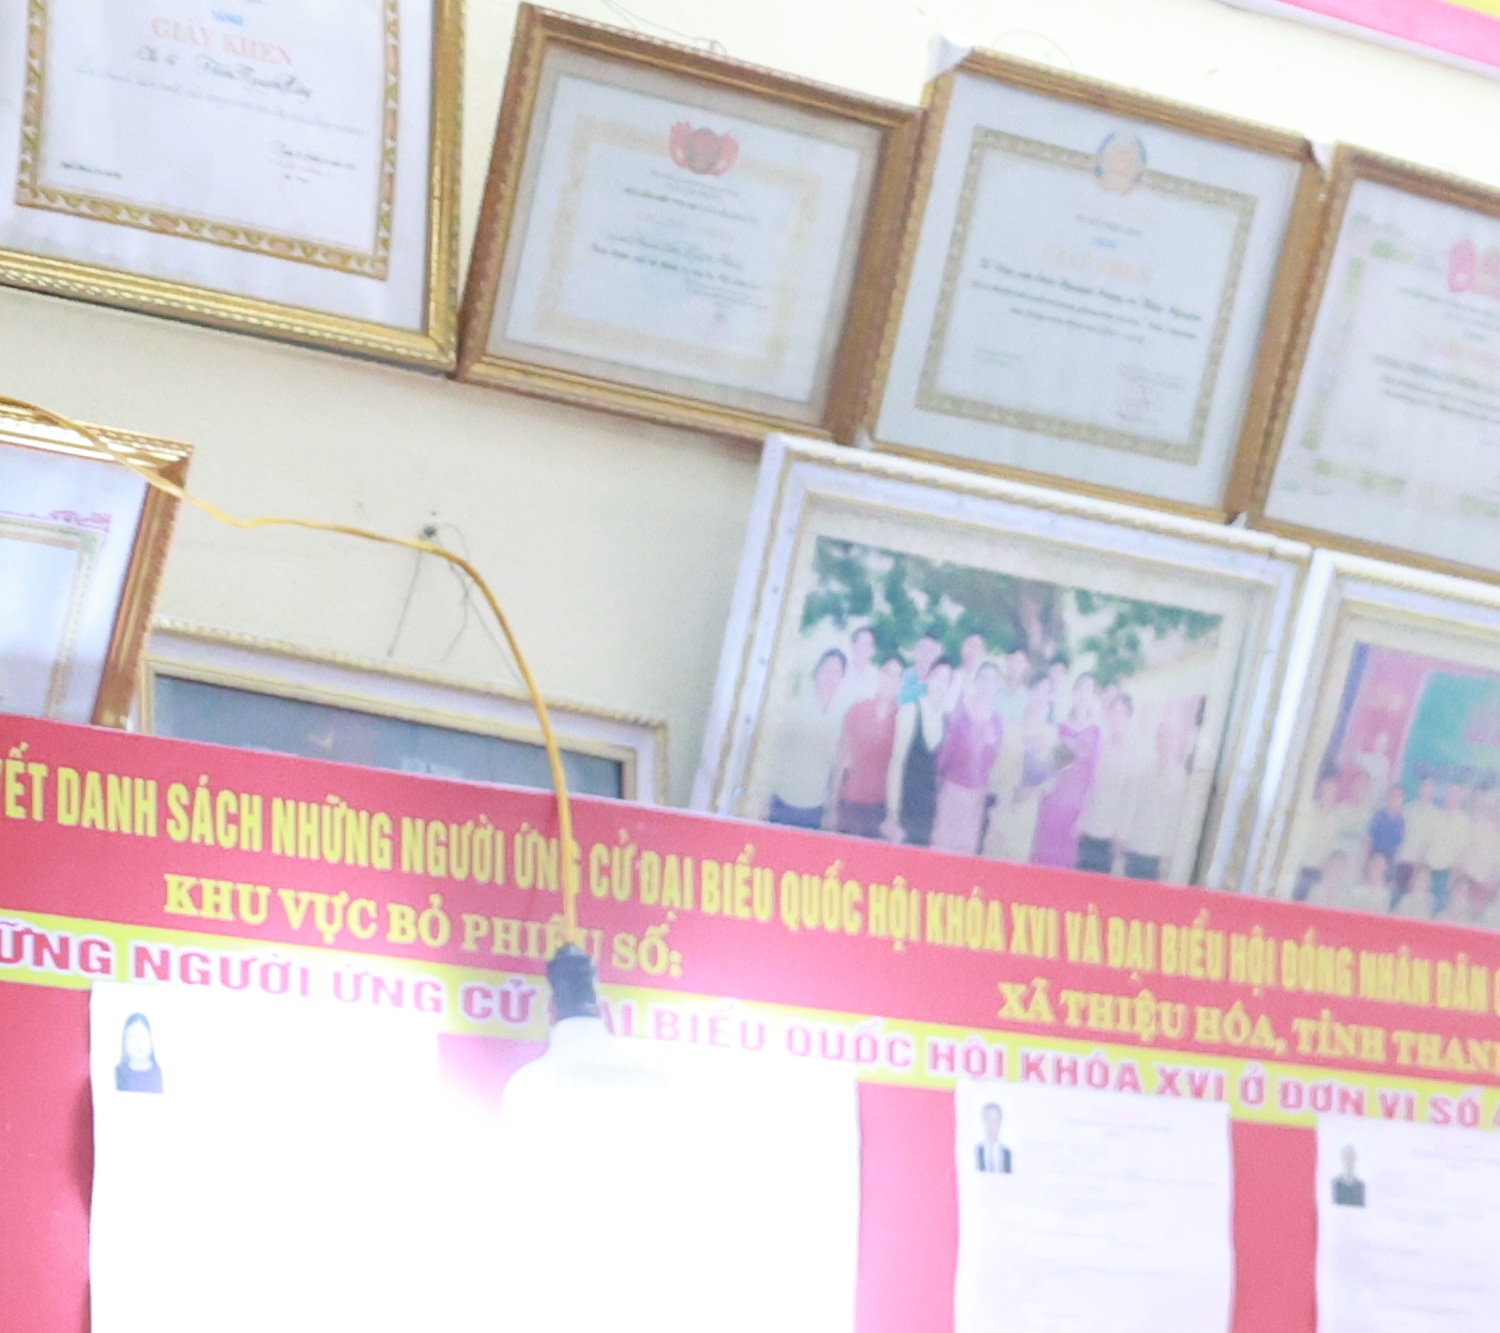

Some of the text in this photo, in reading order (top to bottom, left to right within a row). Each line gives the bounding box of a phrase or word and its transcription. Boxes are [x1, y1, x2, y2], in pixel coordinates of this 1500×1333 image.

[0, 741, 49, 821] ẾT
[56, 766, 158, 838] DANH
[166, 774, 264, 852] SÁCH
[271, 794, 393, 871] NHỮNG
[400, 813, 505, 885] NGƯỜI
[589, 828, 638, 901] CỬ
[639, 849, 694, 921] ĐẠI
[701, 843, 774, 922] BIỂU
[780, 858, 862, 934] QUỐC
[868, 875, 922, 951] HỘI
[926, 885, 1006, 952] KHÓA
[1009, 902, 1058, 959] XVI
[1064, 903, 1101, 965] VÀ
[1106, 916, 1157, 981] ĐẠI
[1161, 908, 1227, 981] BIỂU
[1229, 925, 1276, 996] HỘI
[1359, 946, 1431, 1008] NHÂN
[1437, 953, 1489, 1014] DÂN
[164, 873, 272, 925] KHU
[278, 887, 378, 945] VỰC
[386, 893, 451, 948] BỎ
[611, 922, 683, 979] SỐ:
[133, 944, 309, 997] NGƯỜI
[333, 963, 442, 1013] ỨNG
[462, 978, 536, 1024] CỬ
[1021, 1050, 1142, 1093] KHÓA
[1155, 1066, 1225, 1102] XVI
[1279, 1080, 1365, 1117] ĐƠN
[1428, 1088, 1481, 1128] SỐ
[998, 976, 1054, 1024] XÃ
[1060, 988, 1187, 1041] THIỆU
[1194, 1000, 1287, 1056] HÓA,
[1291, 1008, 1388, 1063] TỈNH
